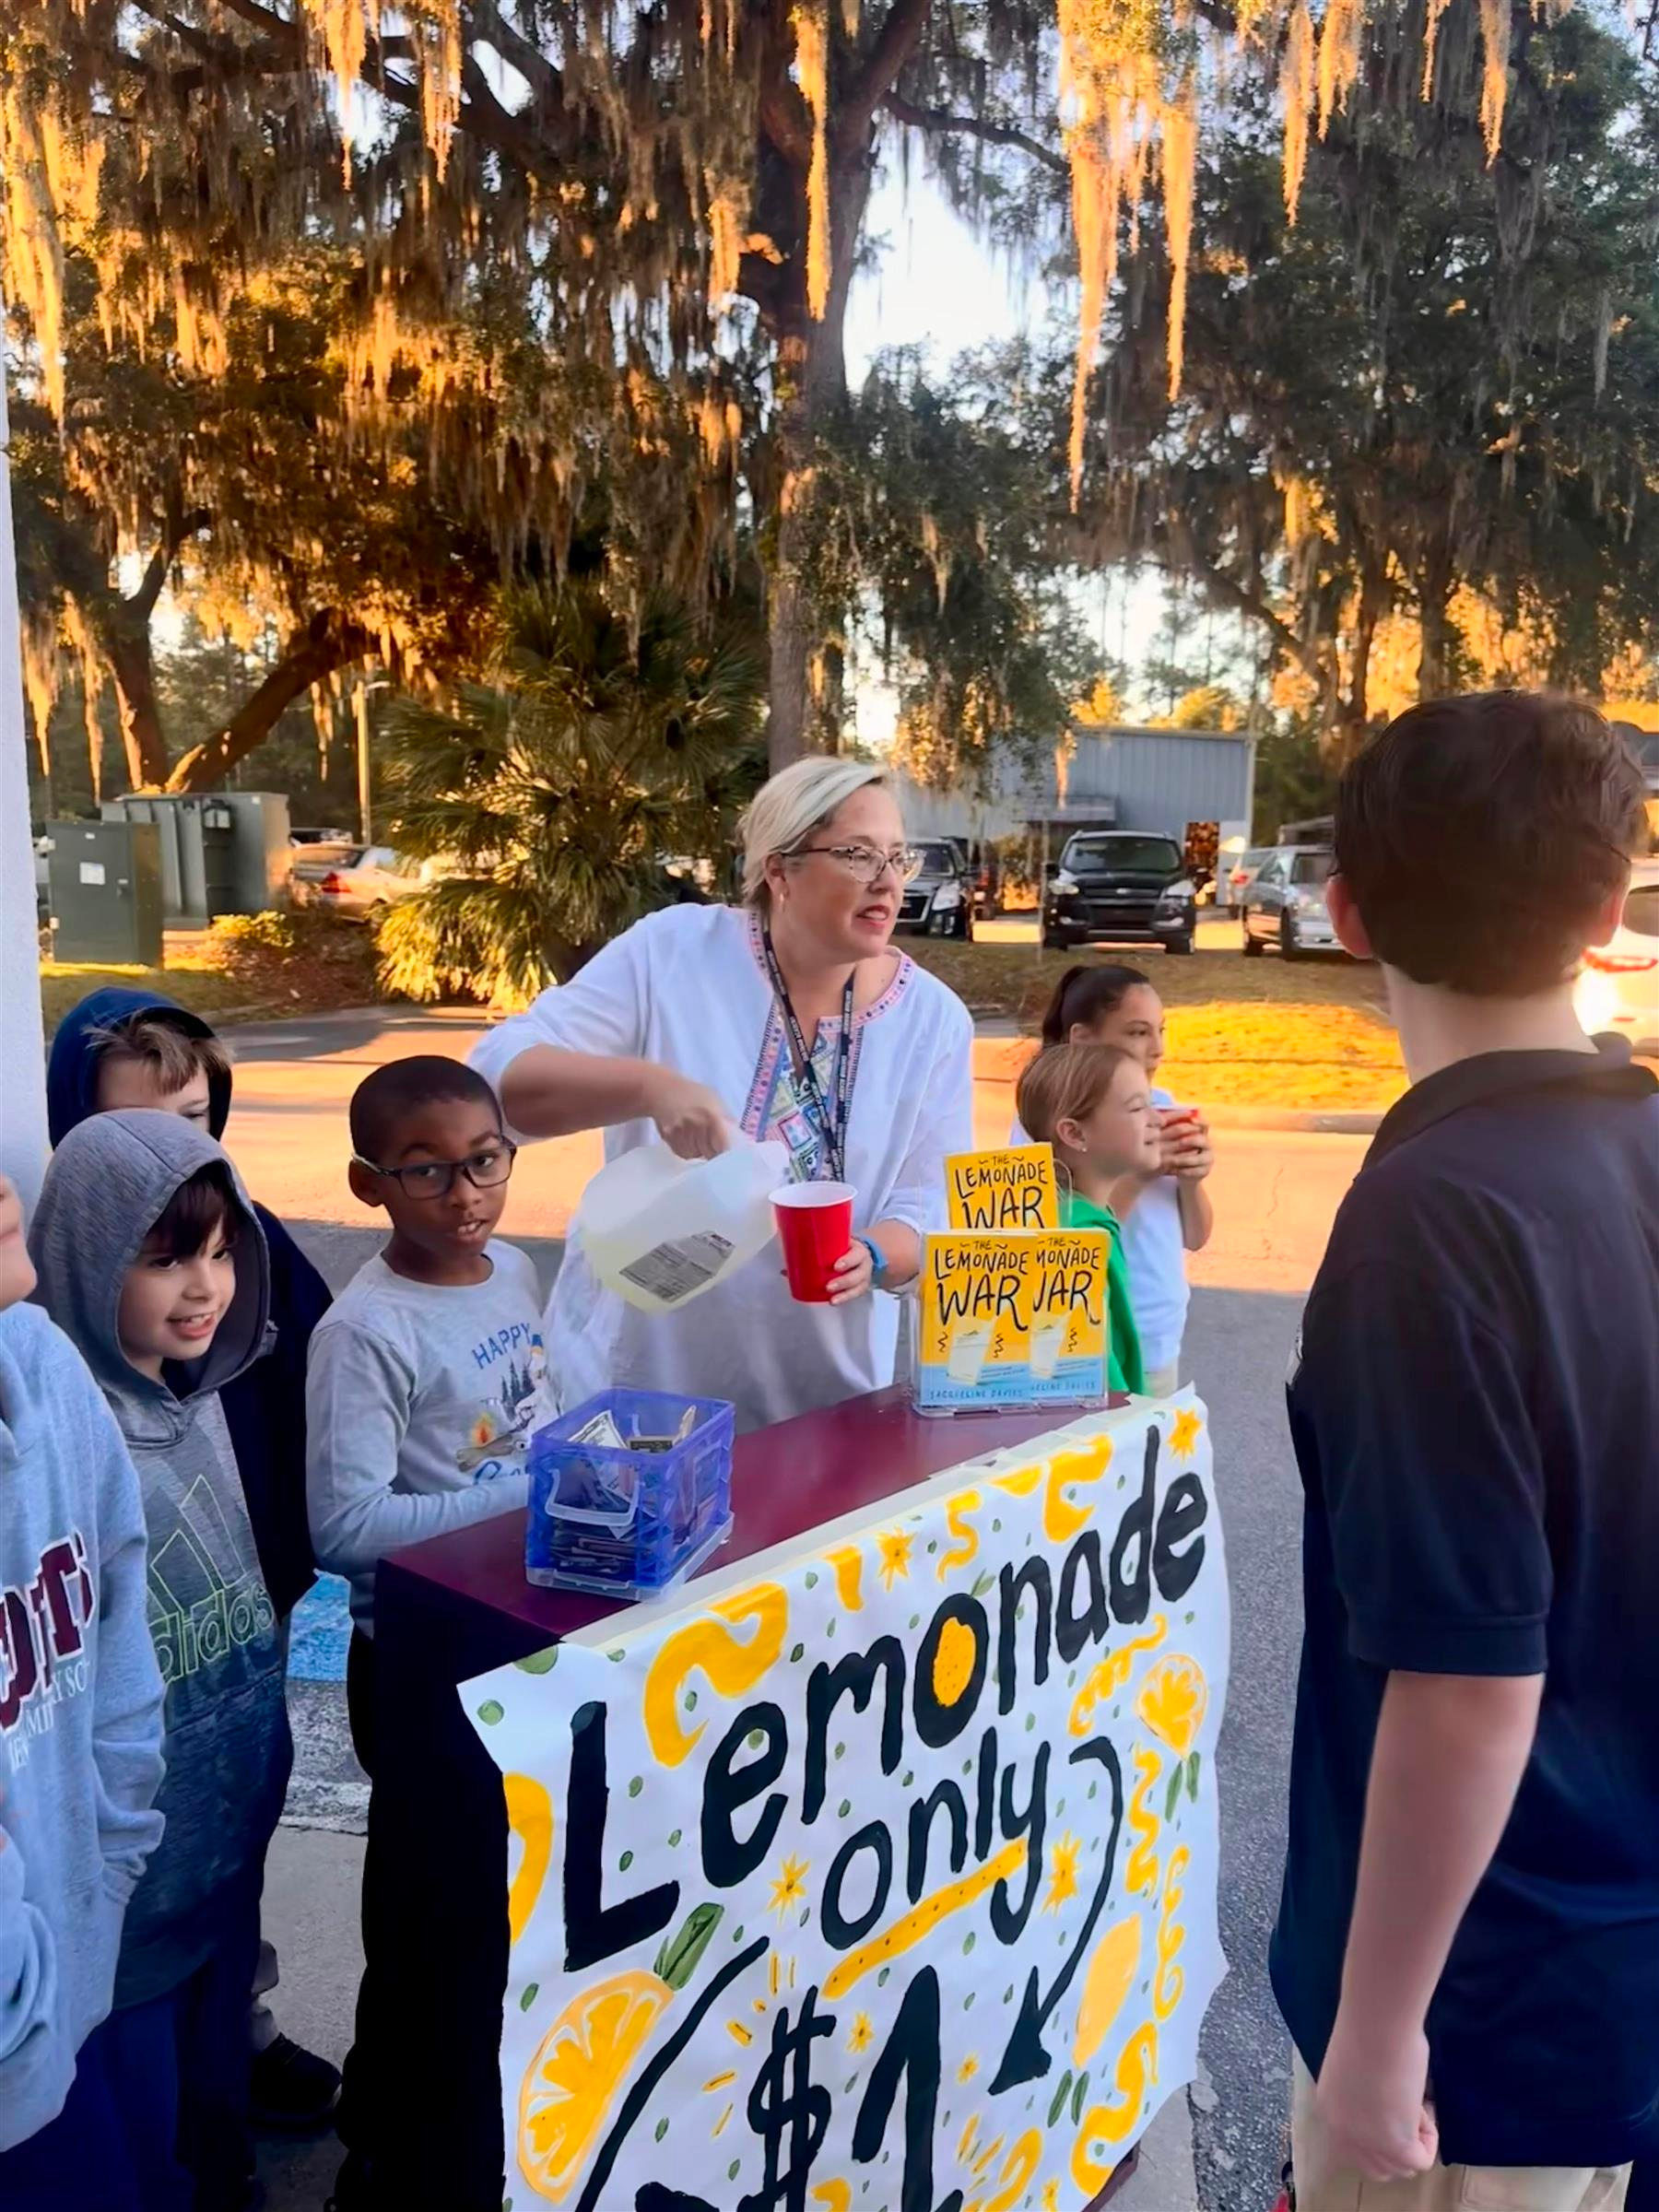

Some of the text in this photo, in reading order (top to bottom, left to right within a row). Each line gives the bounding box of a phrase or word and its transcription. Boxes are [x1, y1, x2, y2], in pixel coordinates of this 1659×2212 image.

[956, 1160, 1048, 1199] LEMONADE
[992, 1154, 1010, 1165] THE
[961, 1185, 1044, 1229] WAR
[973, 1239, 992, 1250] THE
[1036, 1246, 1101, 1270] MONADE
[1048, 1237, 1065, 1247] THE
[935, 1248, 1030, 1280] LEMONADE
[936, 1274, 1029, 1332] WAR
[471, 1322, 531, 1370] HAPPY
[147, 1583, 275, 1685] didas
[564, 1425, 1209, 1972] Lemonade
[820, 1726, 1052, 1949] only
